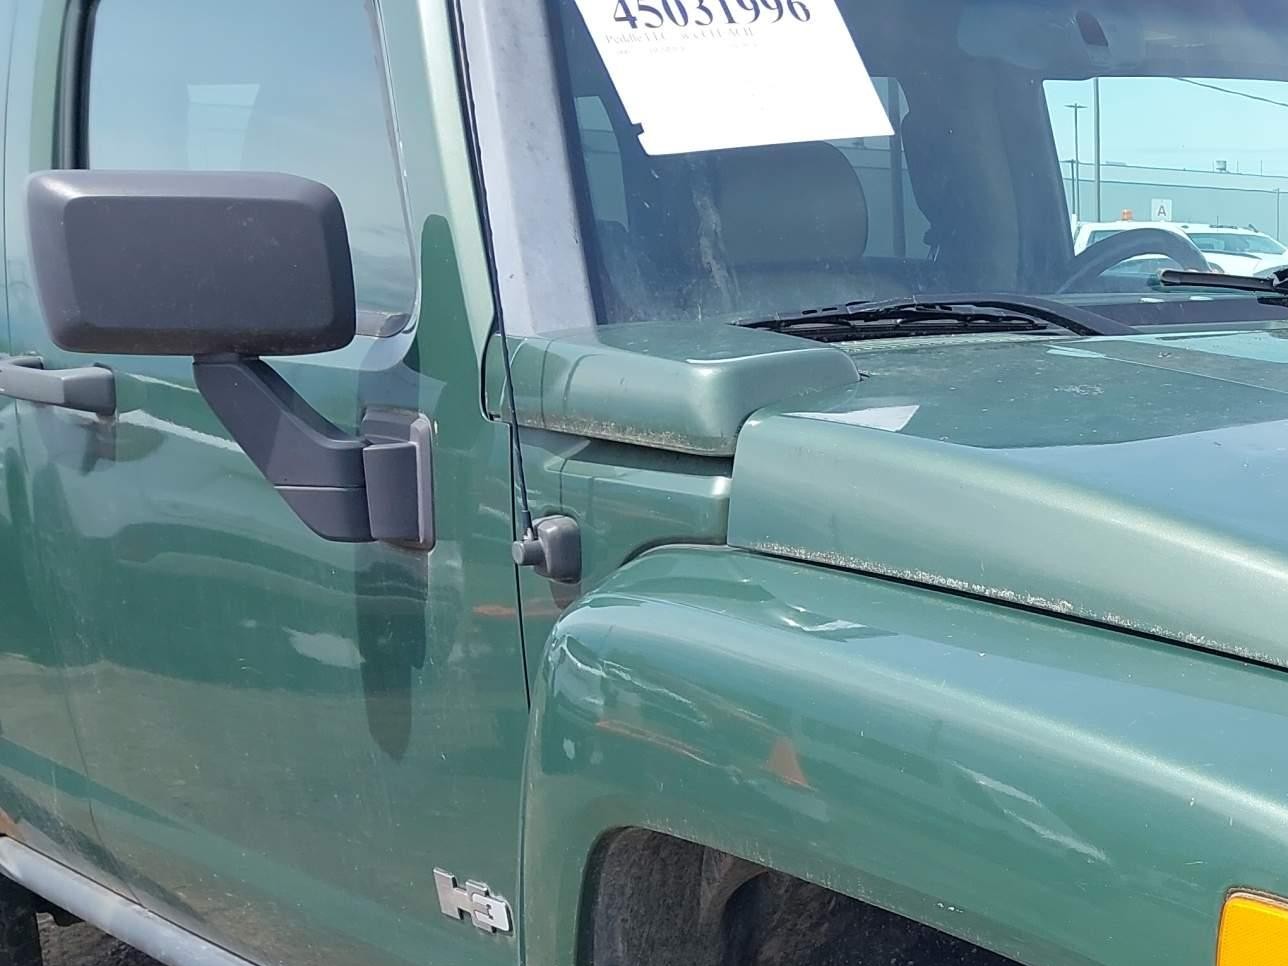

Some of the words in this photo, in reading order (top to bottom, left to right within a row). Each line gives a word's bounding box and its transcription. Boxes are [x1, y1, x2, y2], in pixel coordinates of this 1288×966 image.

[614, 0, 811, 29] 45031996
[1156, 205, 1168, 217] A
[433, 866, 513, 935] H3
